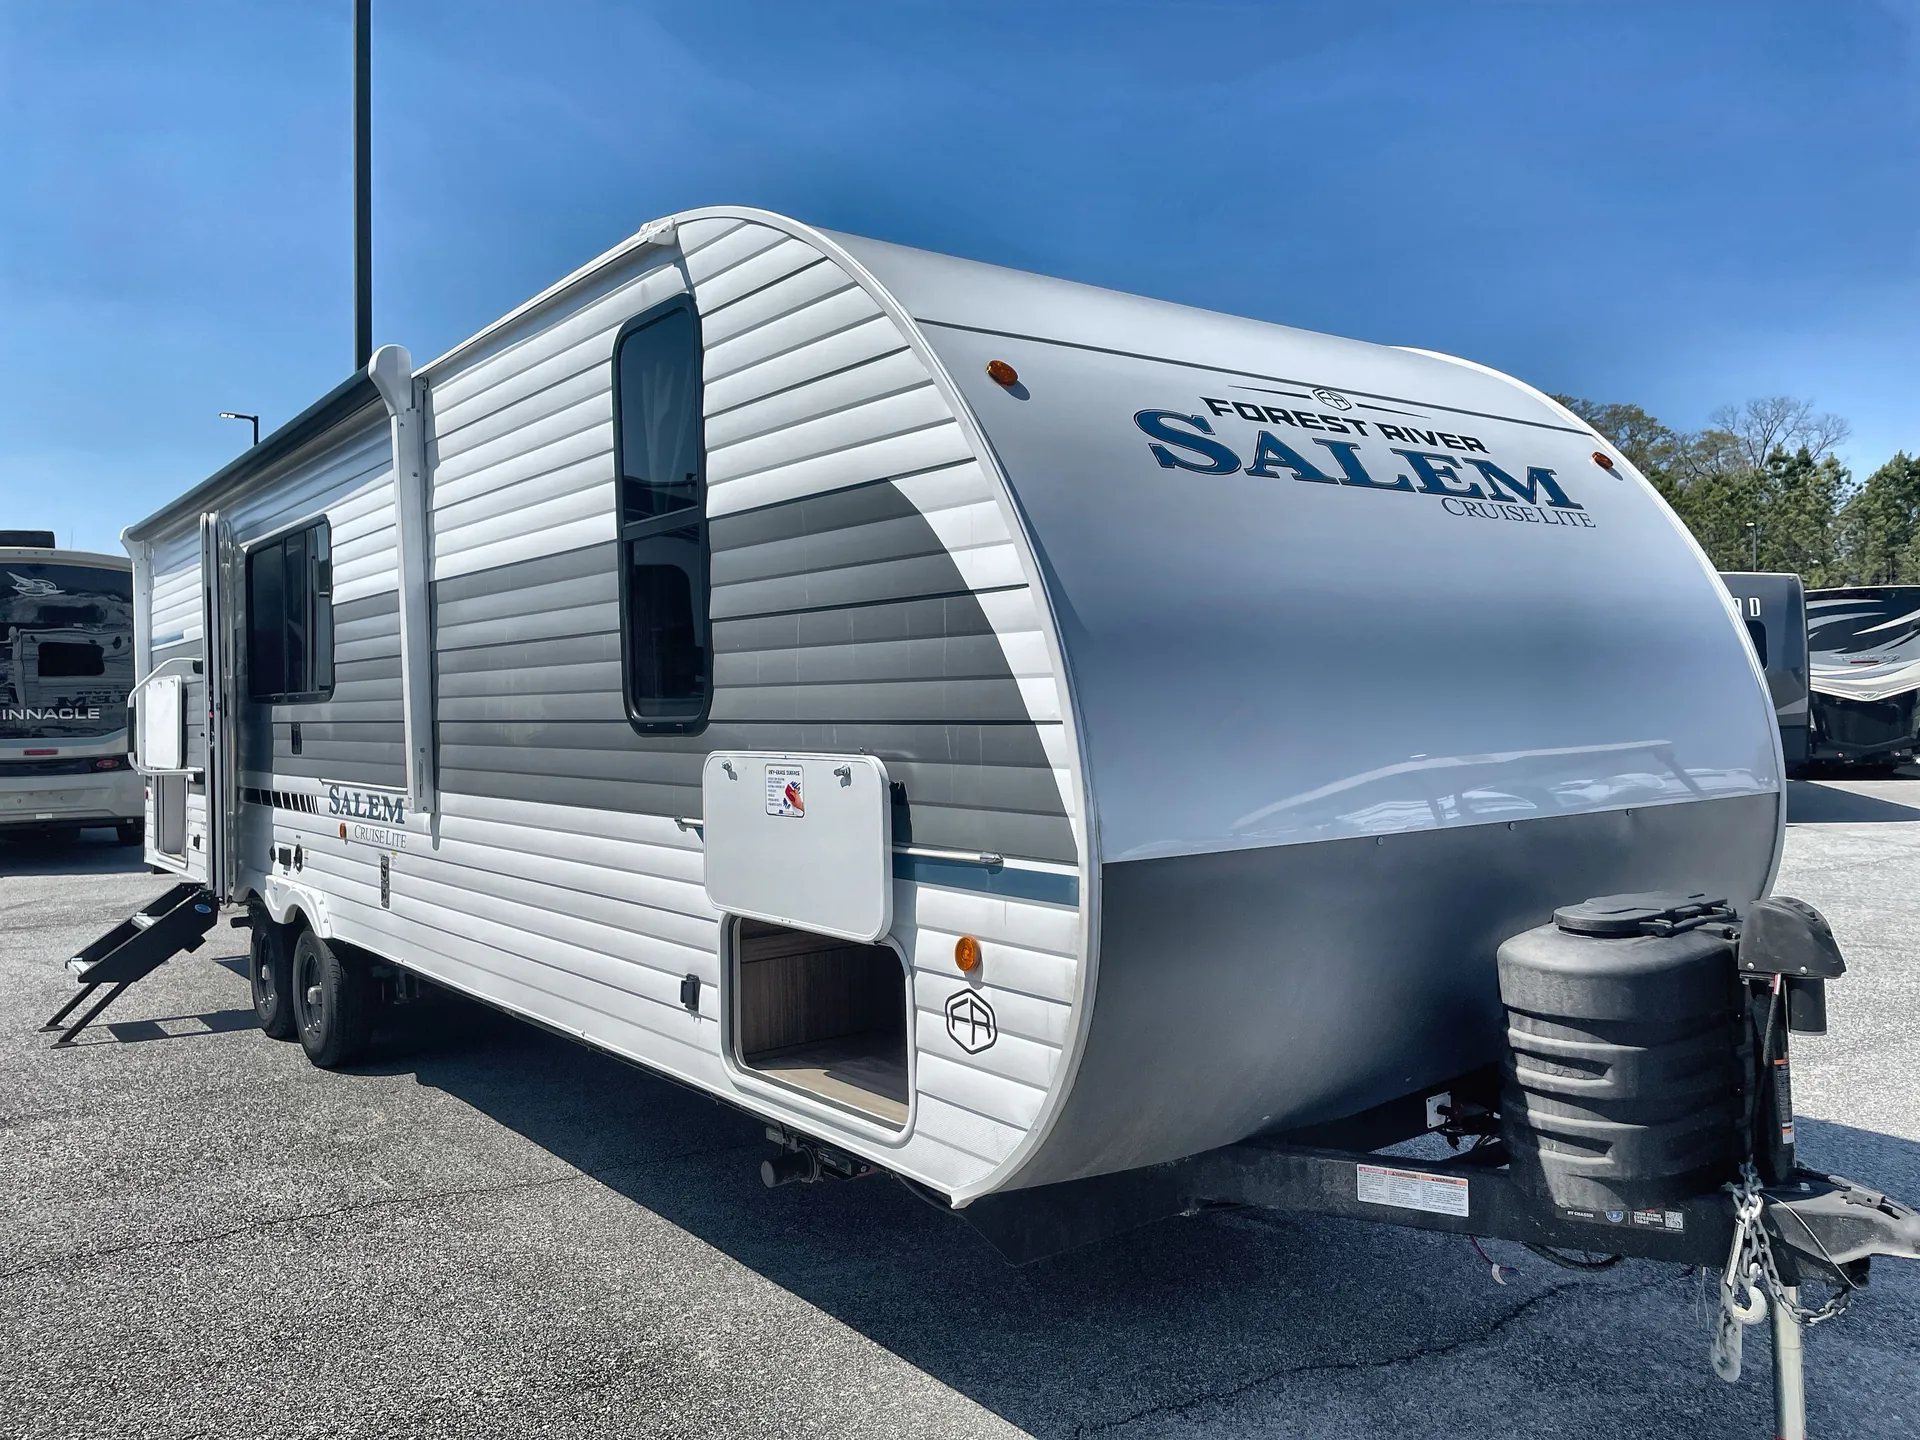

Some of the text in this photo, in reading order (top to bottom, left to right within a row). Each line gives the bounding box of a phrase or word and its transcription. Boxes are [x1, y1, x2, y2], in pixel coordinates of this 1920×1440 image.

[1199, 396, 1491, 454] FOREST RIVER
[1133, 408, 1584, 511] SALEM
[328, 784, 405, 825] SALEM
